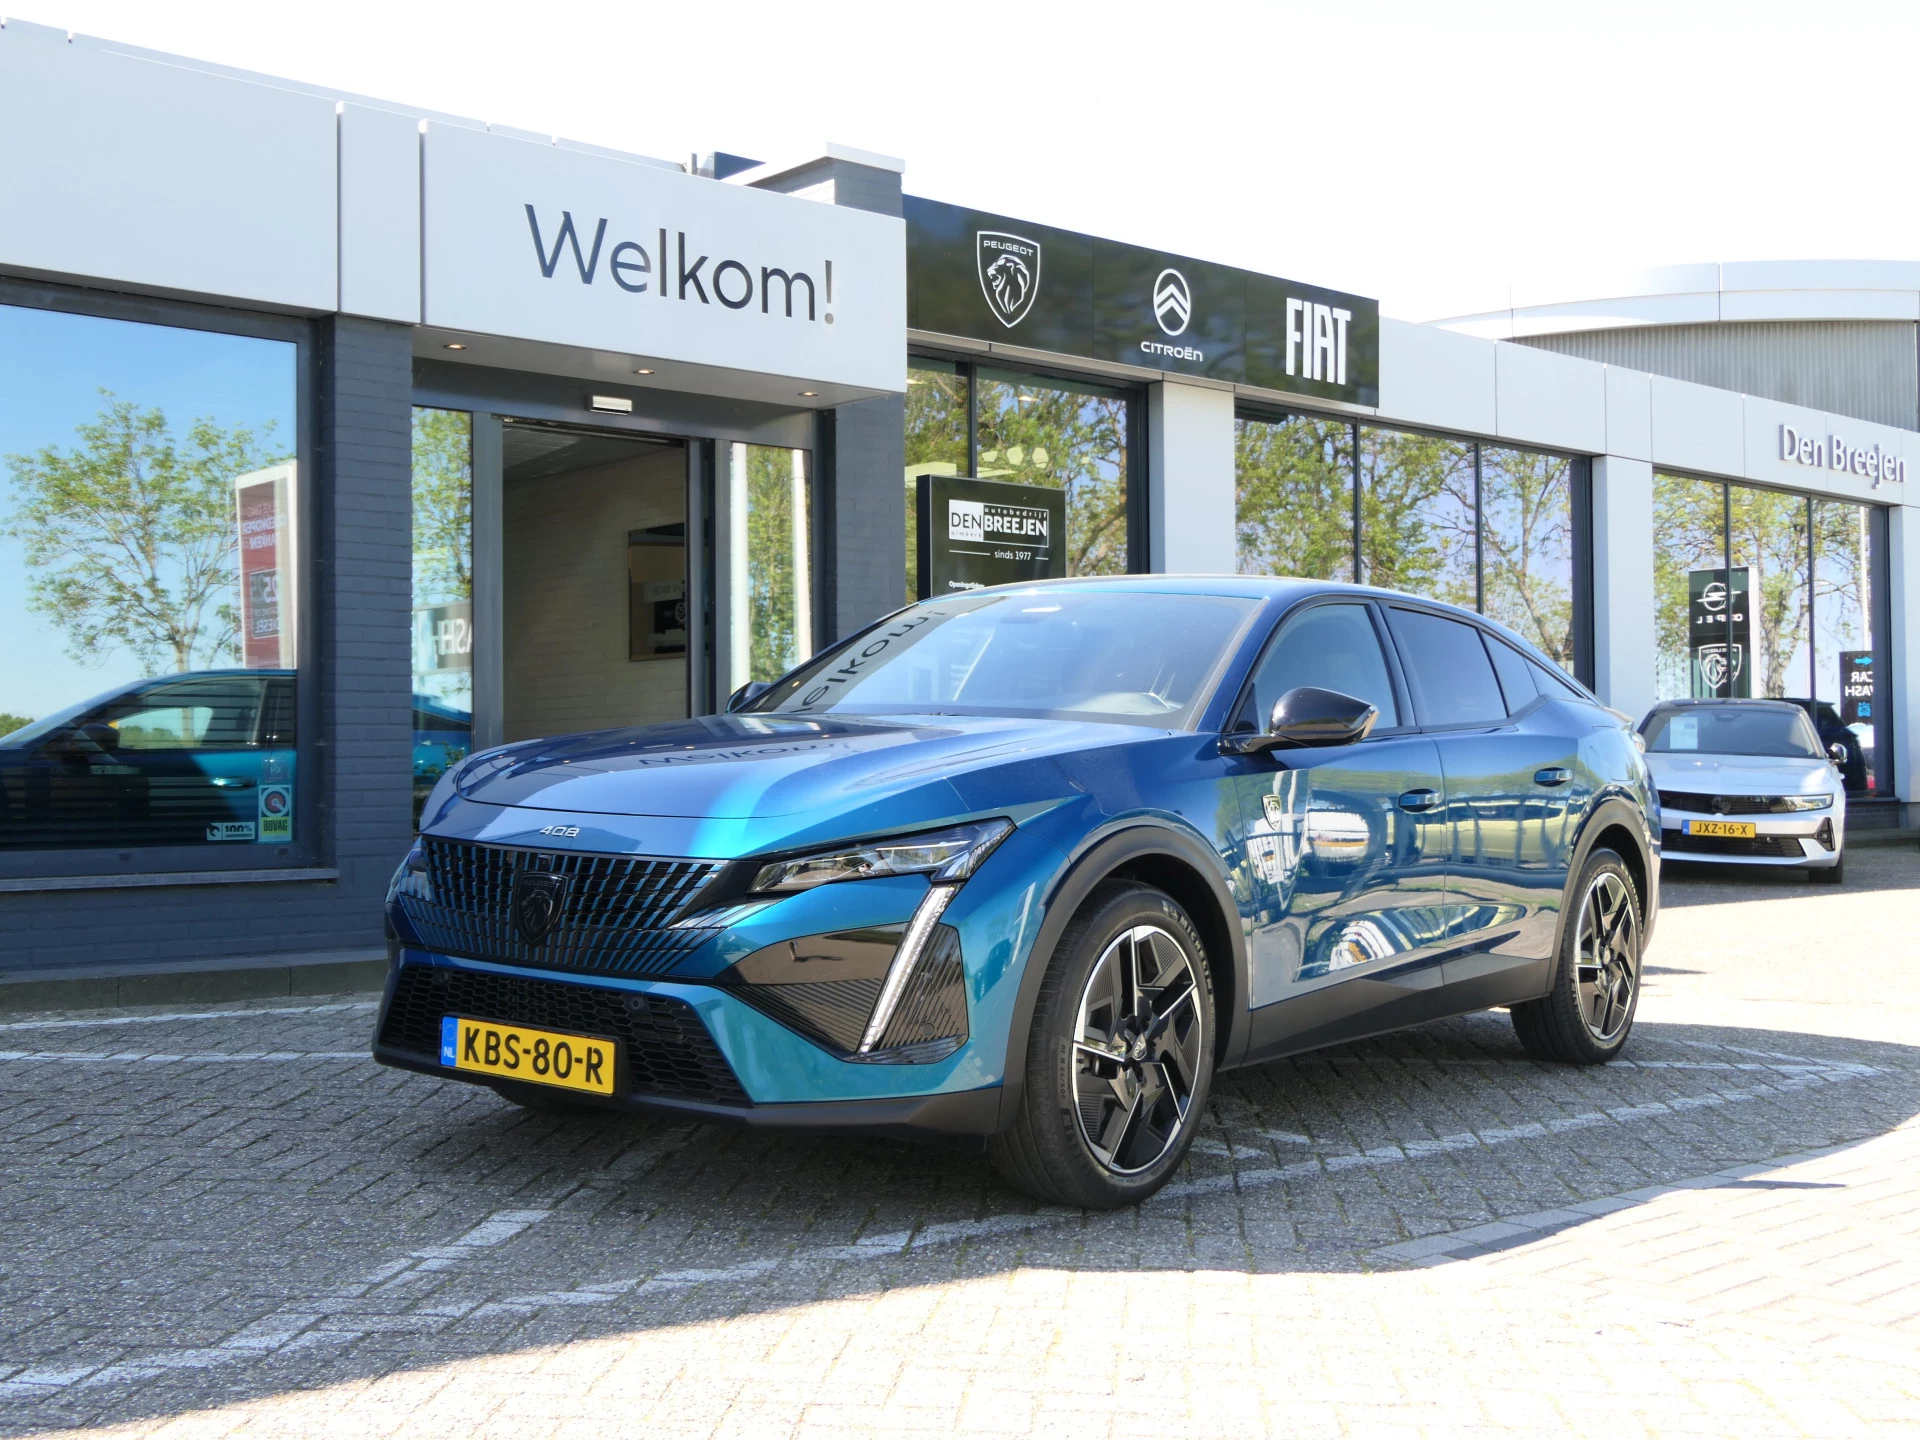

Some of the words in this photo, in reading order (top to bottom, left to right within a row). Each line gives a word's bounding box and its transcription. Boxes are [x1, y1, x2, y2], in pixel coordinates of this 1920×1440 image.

[983, 239, 1035, 257] PEUGEOT
[524, 203, 835, 325] Welkom!
[1285, 297, 1352, 386] FIAT
[1778, 423, 1825, 468] Den
[1828, 433, 1907, 490] Breejen
[951, 512, 982, 530] DEN
[984, 507, 1047, 519] autobedrijf
[984, 515, 1047, 537] BREEJEN
[994, 551, 1014, 560] sinds
[1015, 551, 1032, 561] 1977
[224, 824, 253, 833] 100%
[263, 820, 288, 832] BOVAG
[538, 825, 580, 838] 408
[1695, 822, 1748, 835] JXZ-16-X
[1179, 915, 1214, 990] MICHELIN
[443, 1045, 455, 1059] NL
[464, 1026, 604, 1085] KBS-80-R
